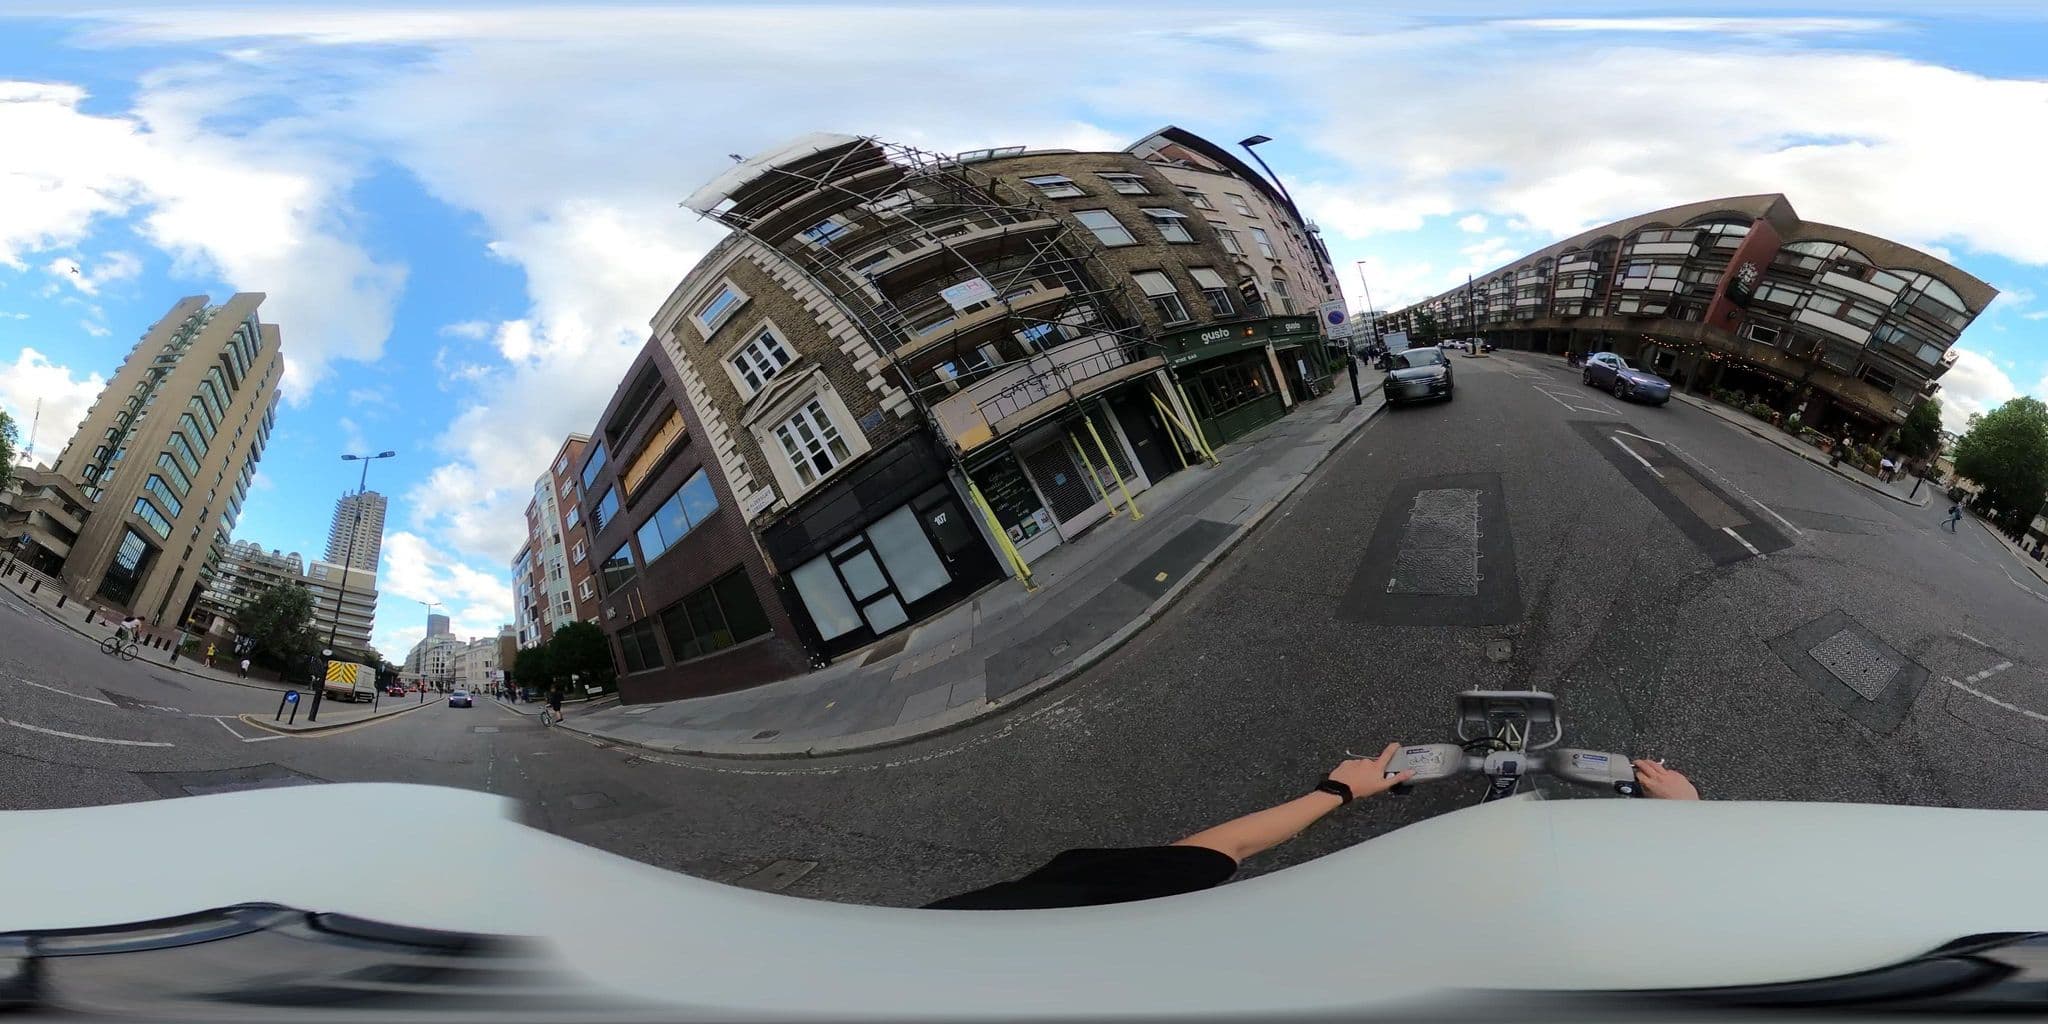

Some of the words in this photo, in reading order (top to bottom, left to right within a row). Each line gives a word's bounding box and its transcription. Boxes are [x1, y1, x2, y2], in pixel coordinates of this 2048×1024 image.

[1285, 322, 1300, 332] gusto
[1201, 328, 1230, 345] gusto
[934, 512, 947, 526] 107
